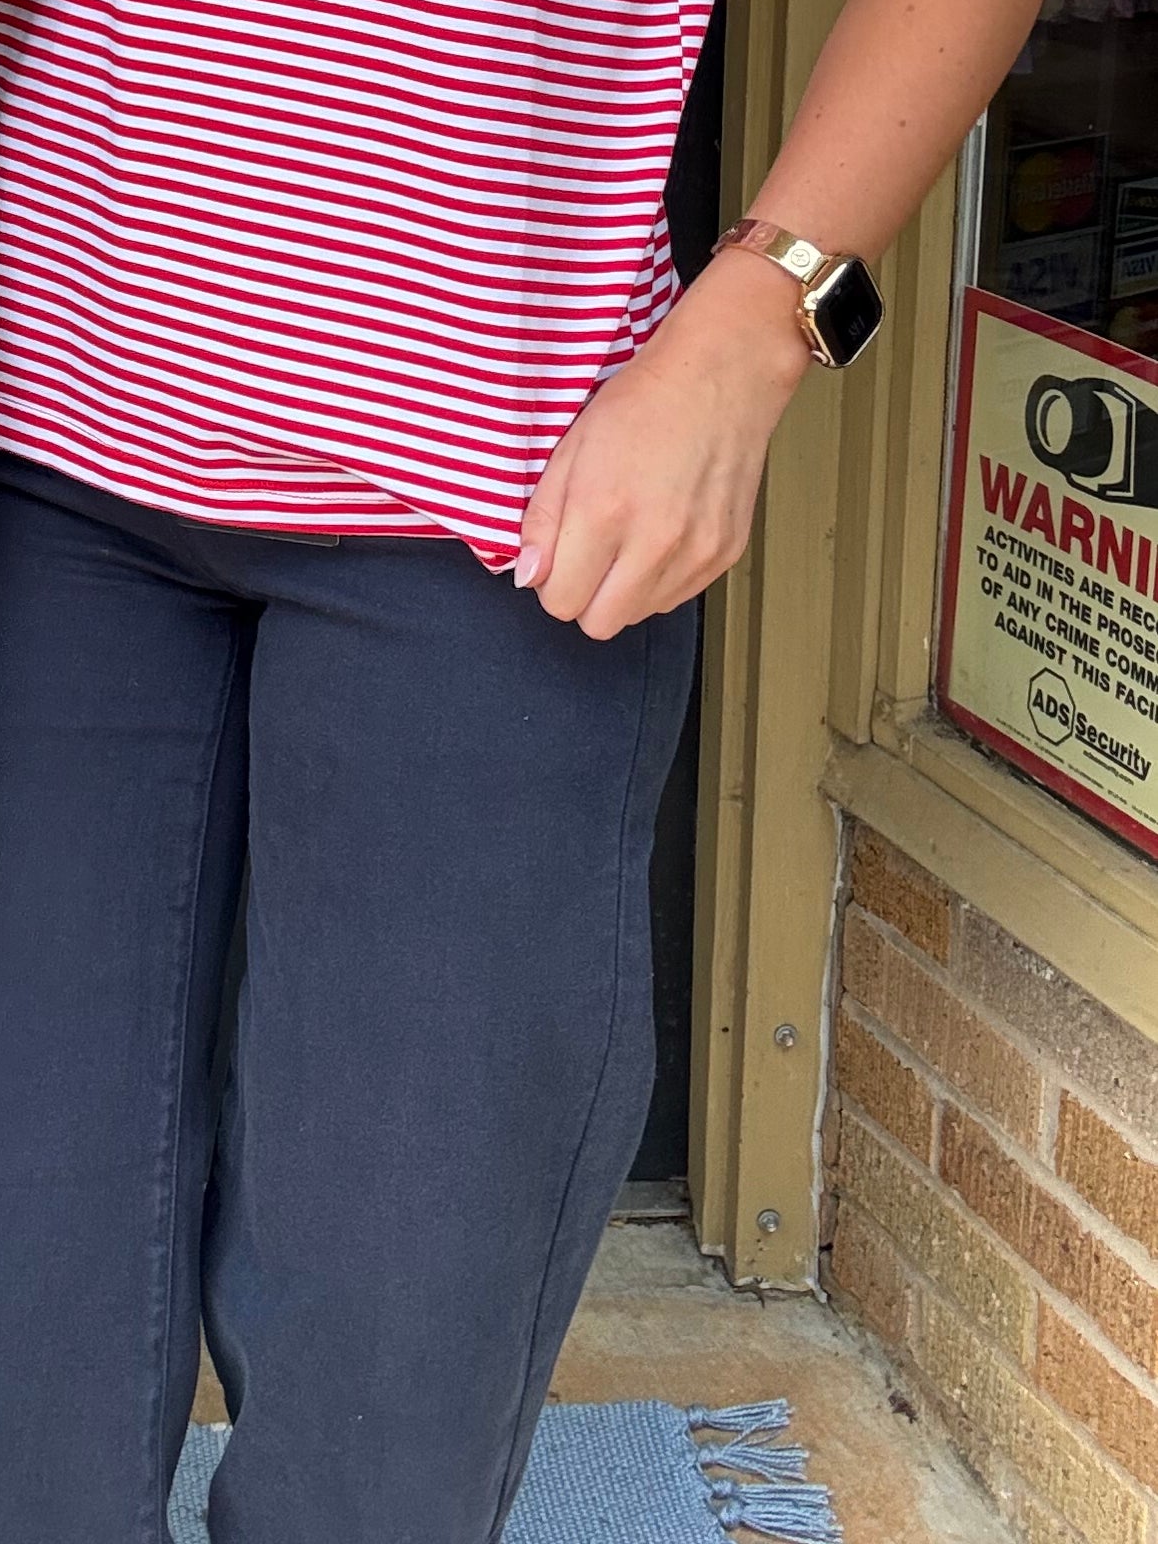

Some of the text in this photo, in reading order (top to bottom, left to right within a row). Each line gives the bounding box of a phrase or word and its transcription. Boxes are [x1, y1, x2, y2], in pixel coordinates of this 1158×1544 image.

[979, 454, 1158, 603] WARNI
[977, 545, 1158, 664] TO AID IN THE PROSE
[981, 576, 1003, 600] OF
[1007, 591, 1041, 622] ANY
[1045, 612, 1101, 659] CRIME
[984, 525, 1158, 634] ACTIVITIES ARE REC
[994, 611, 1068, 665] AGAINST
[1072, 654, 1110, 693] THIS
[1032, 688, 1071, 726] ADS
[1075, 712, 1151, 781] Security
